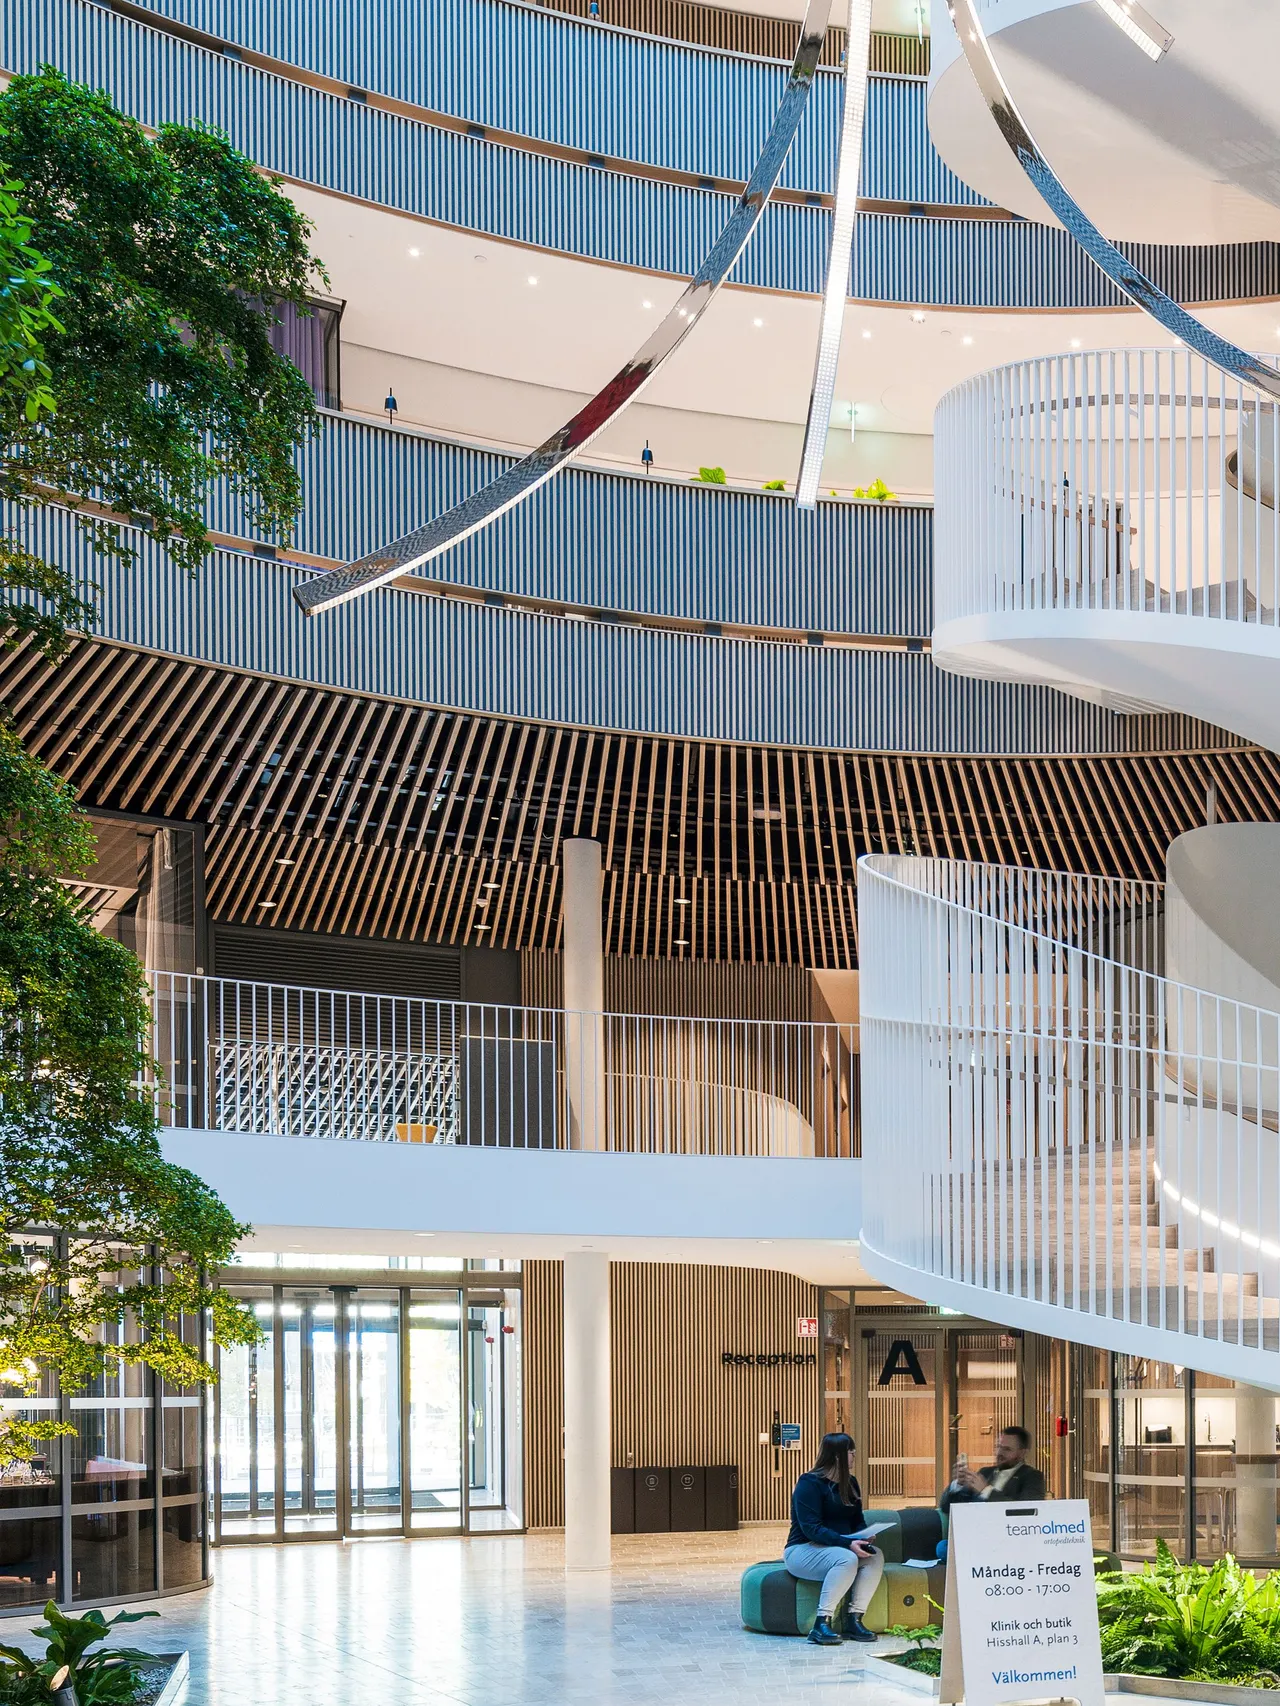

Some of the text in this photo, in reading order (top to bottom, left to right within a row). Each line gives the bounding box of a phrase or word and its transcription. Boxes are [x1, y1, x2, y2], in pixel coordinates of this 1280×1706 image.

[721, 1352, 817, 1368] Reception
[878, 1340, 927, 1385] A
[1006, 1519, 1085, 1536] teamolmed
[1043, 1536, 1086, 1546] ortopedteknik
[971, 1564, 1026, 1580] Måndag
[1037, 1561, 1082, 1577] Fredag
[985, 1584, 1024, 1596] 08:00
[1036, 1583, 1071, 1596] 17:00
[991, 1616, 1072, 1632] Klinik och butik
[986, 1632, 1079, 1647] Hisshall A, plan 3
[991, 1665, 1077, 1685] Välkommen!
